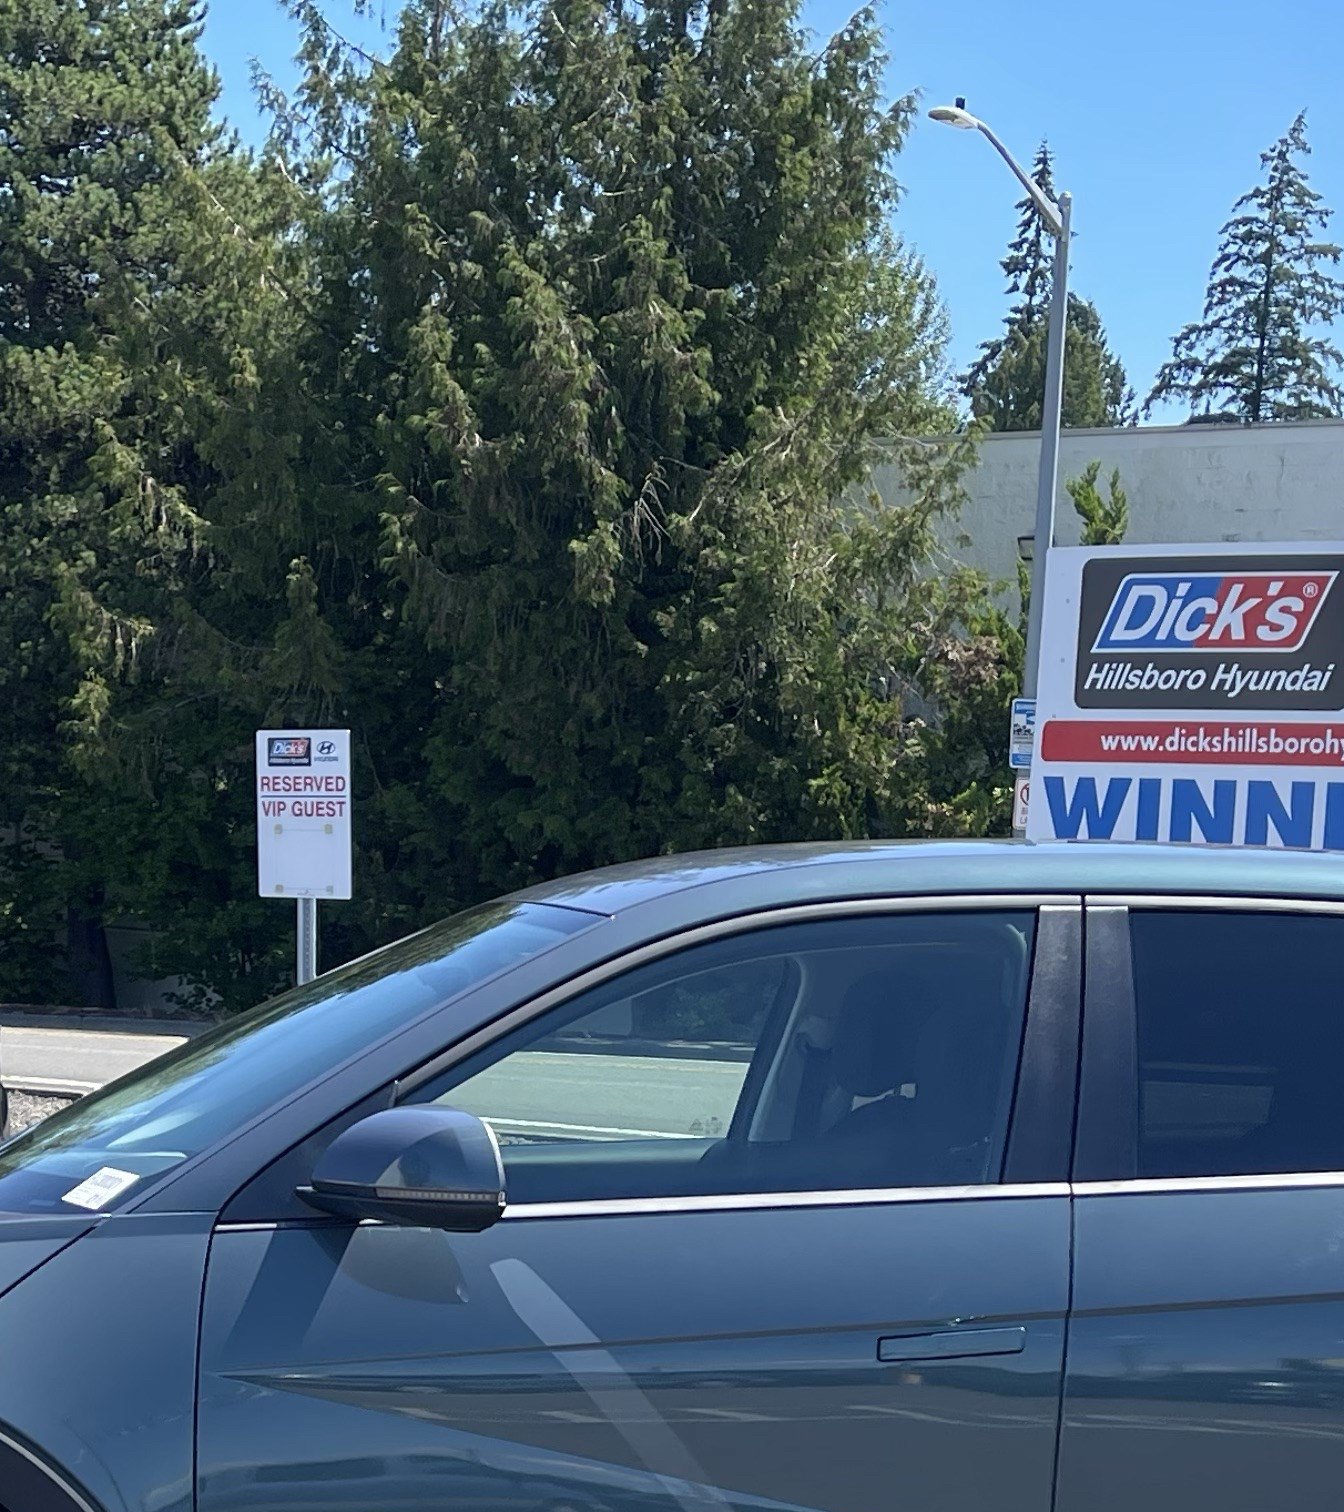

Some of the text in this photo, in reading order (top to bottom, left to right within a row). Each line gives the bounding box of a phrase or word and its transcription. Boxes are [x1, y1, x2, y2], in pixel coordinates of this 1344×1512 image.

[1109, 581, 1305, 642] Dick's
[1083, 662, 1336, 698] Hillsboro Hyundai
[260, 776, 346, 792] RESERVED
[261, 800, 346, 817] VIP GUEST
